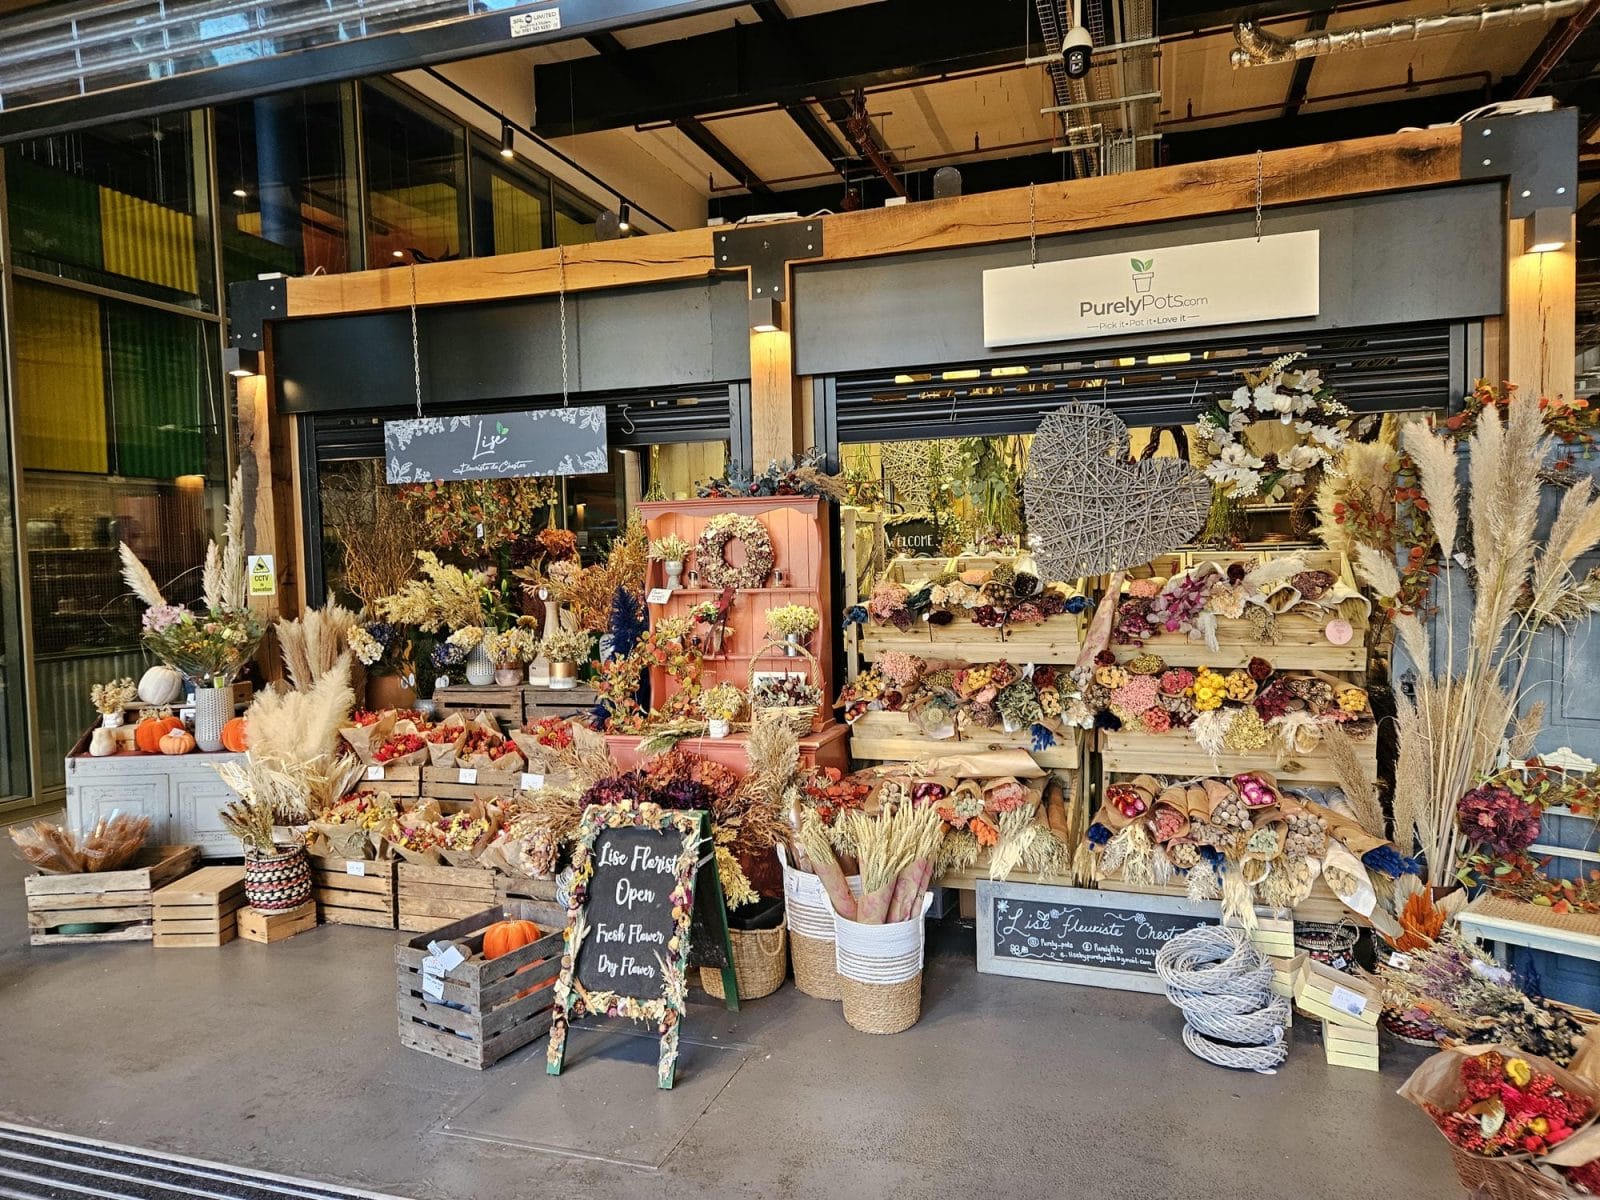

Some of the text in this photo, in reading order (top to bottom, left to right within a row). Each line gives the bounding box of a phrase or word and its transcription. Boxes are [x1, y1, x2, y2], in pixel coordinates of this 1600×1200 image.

[1080, 293, 1208, 317] PurelyPots.com
[1099, 322, 1118, 330] Pick
[1156, 315, 1178, 325] Love
[1180, 314, 1187, 322] it
[472, 419, 508, 460] Lise
[598, 841, 678, 876] Lise Florist
[615, 878, 655, 910] Open
[596, 923, 665, 945] Fresh Flower
[1003, 907, 1051, 937] Lise
[598, 953, 656, 978] Dry Flower
